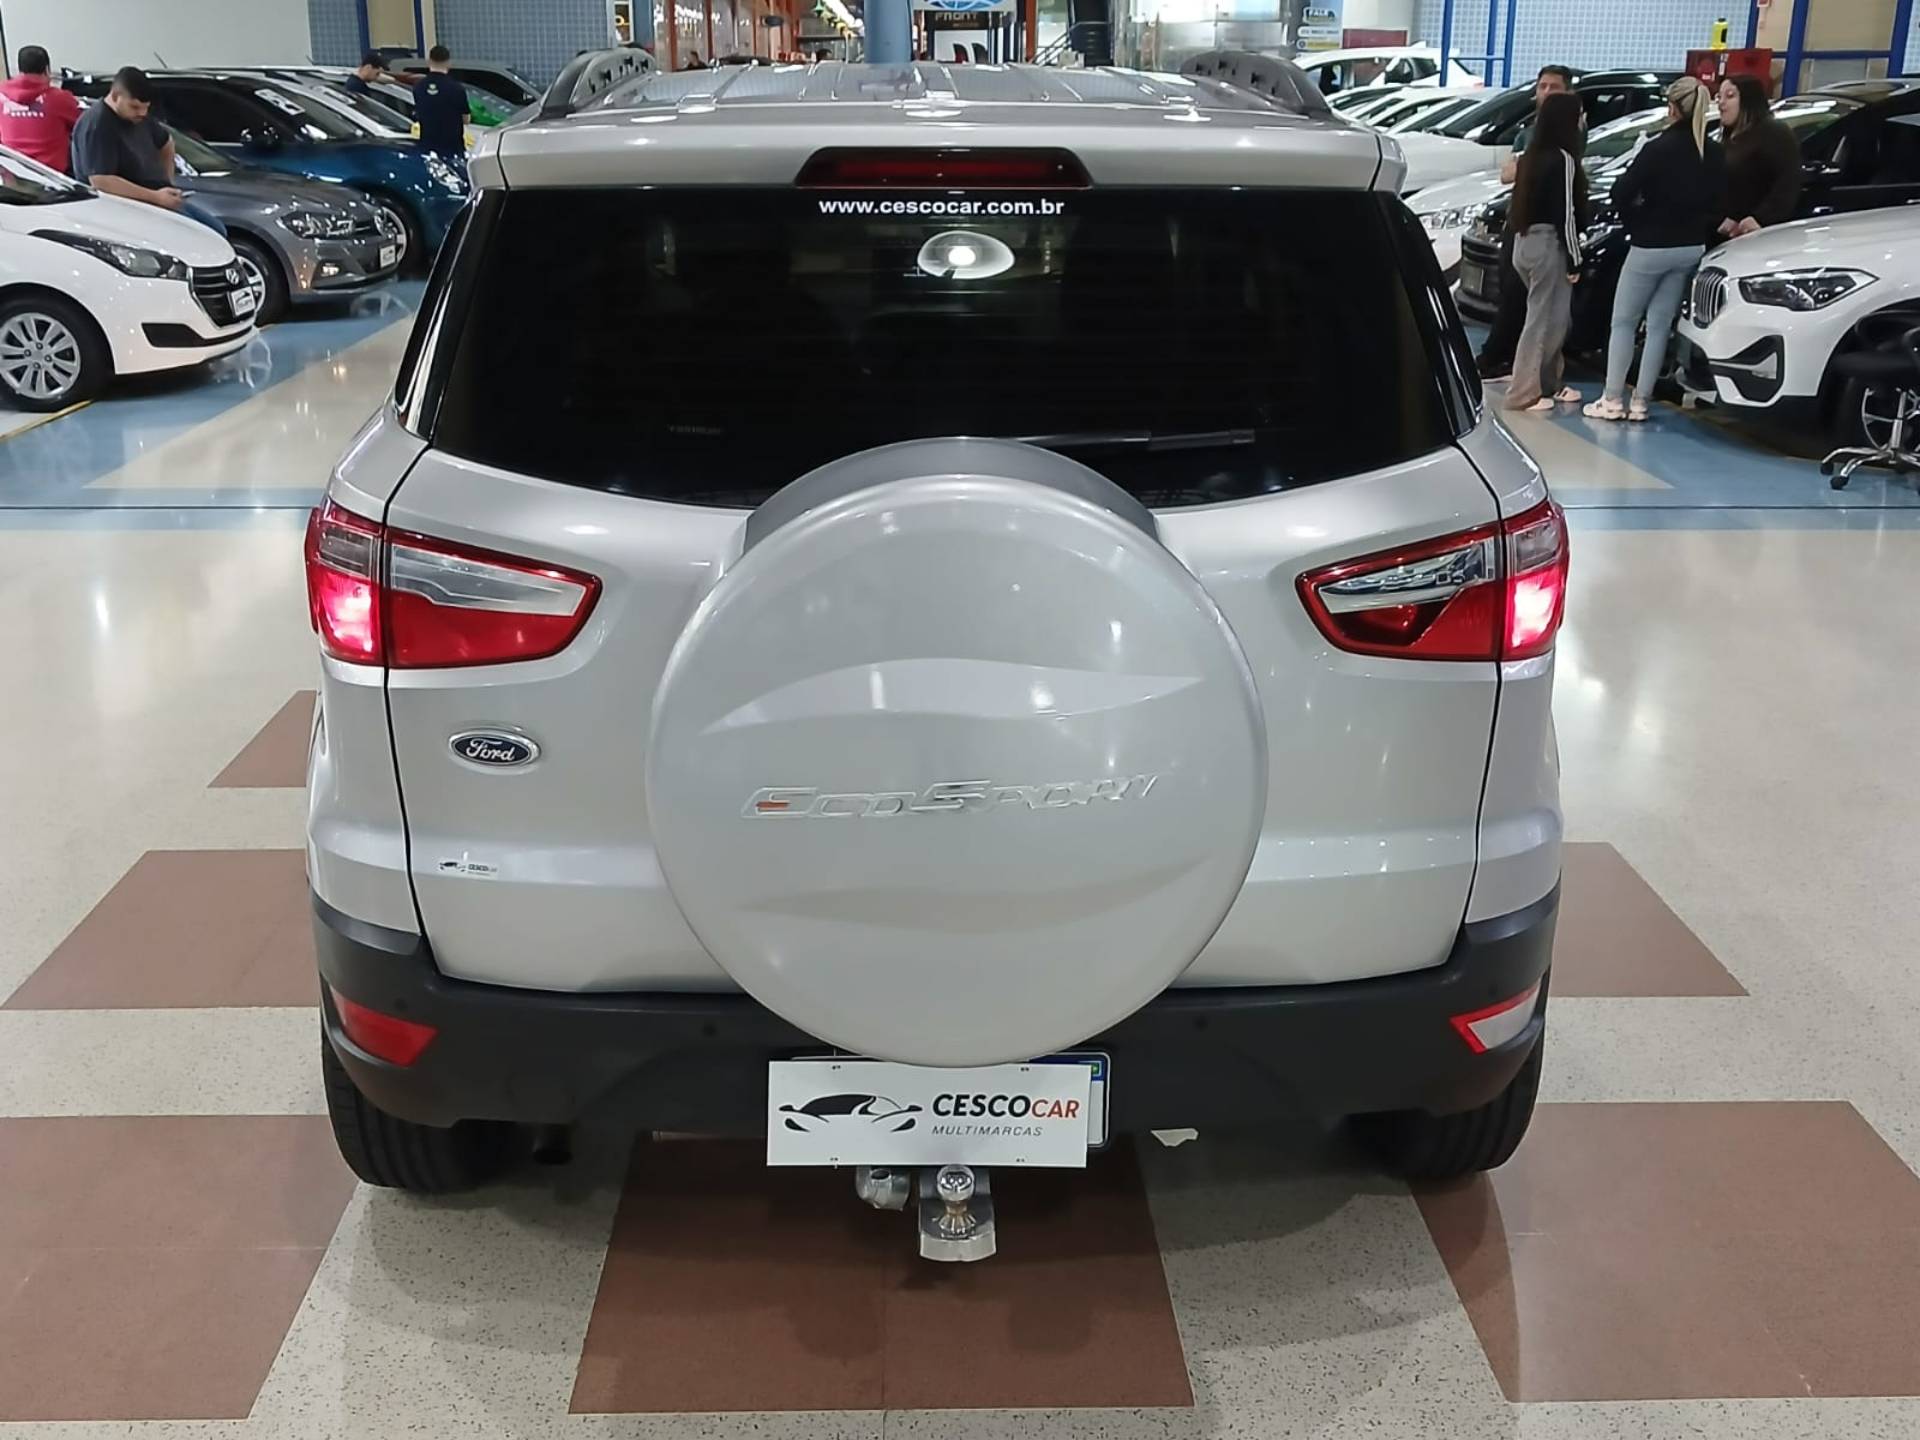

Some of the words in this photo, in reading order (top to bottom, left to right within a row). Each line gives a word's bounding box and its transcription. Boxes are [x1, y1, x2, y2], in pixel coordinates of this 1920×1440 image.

[818, 199, 1065, 215] www.cescocar.com.br
[465, 738, 516, 761] Ford
[932, 1093, 1080, 1119] CESCOCAR
[931, 1124, 1044, 1137] MULTIMARCAS
